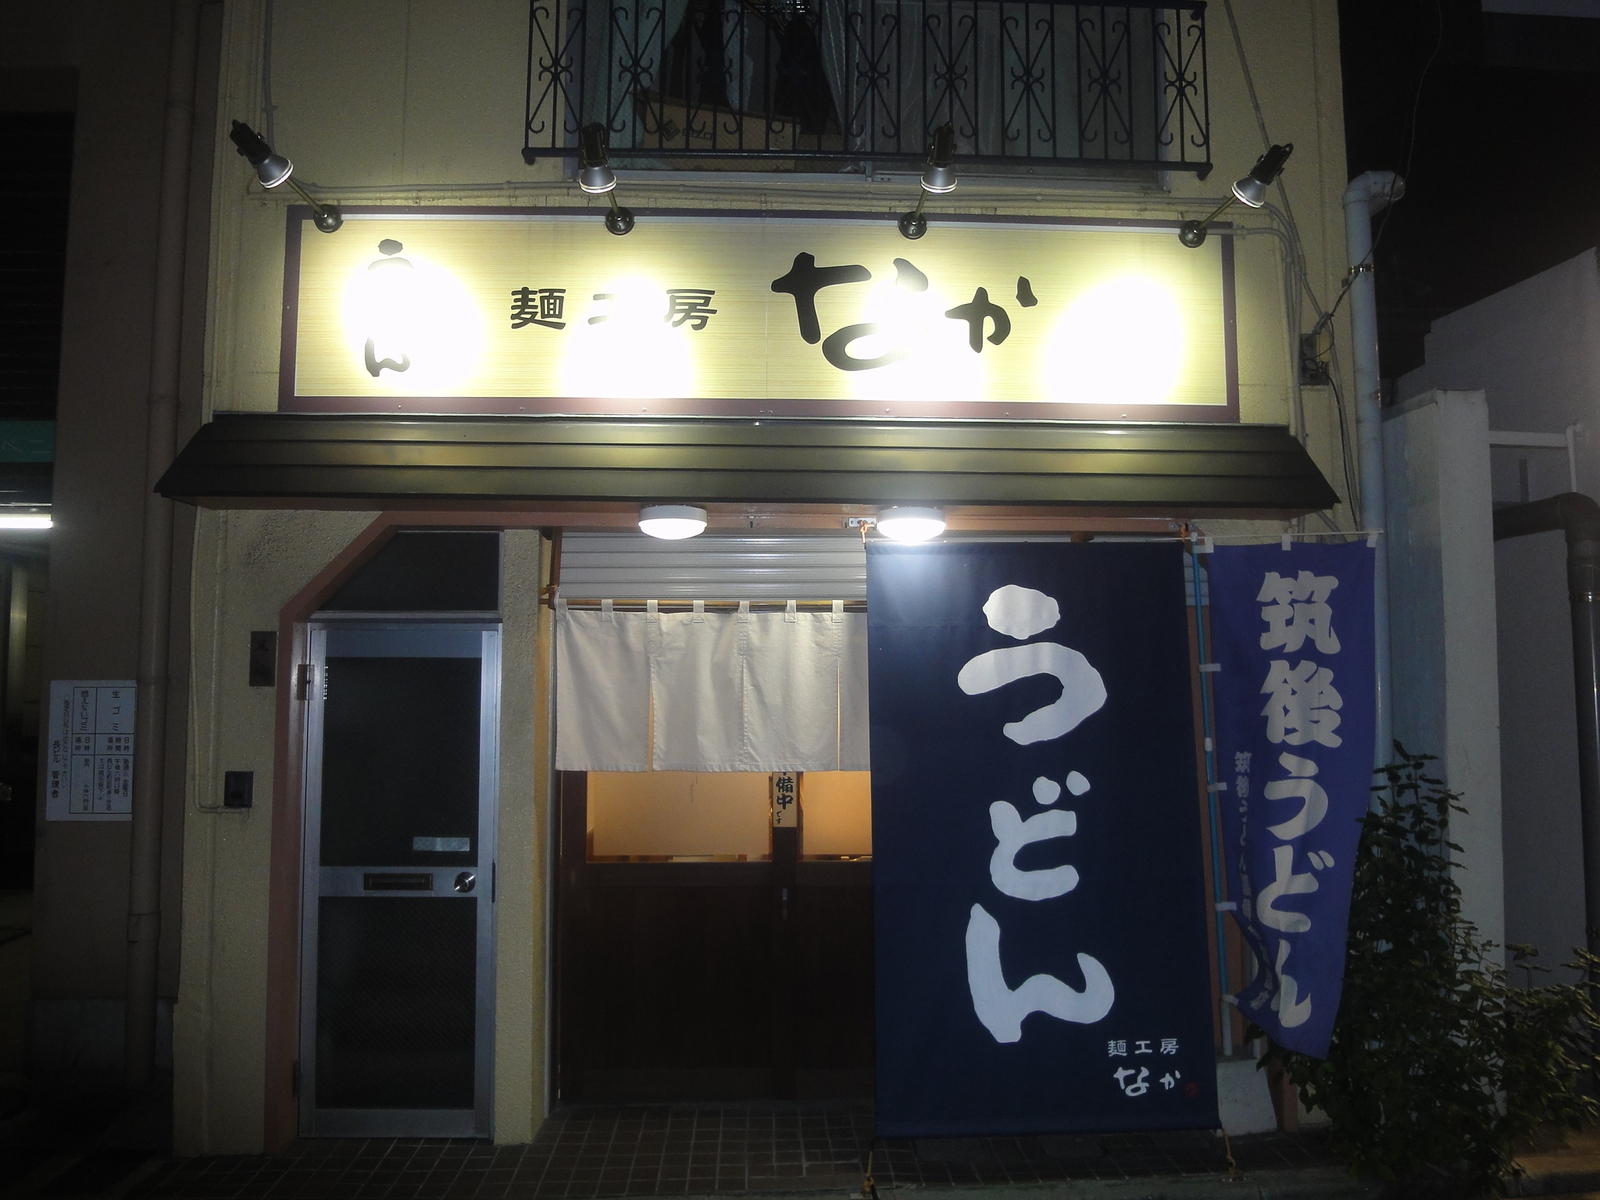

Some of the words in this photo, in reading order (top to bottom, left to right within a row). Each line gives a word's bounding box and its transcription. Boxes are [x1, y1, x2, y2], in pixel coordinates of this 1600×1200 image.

[771, 251, 1039, 372] なか
[112, 690, 121, 732] 生ゴミ
[957, 584, 1115, 1043] うどん
[1256, 570, 1344, 1028] 筑後うどん
[1107, 1038, 1179, 1057] 麺工房
[1113, 1066, 1181, 1097] なか
